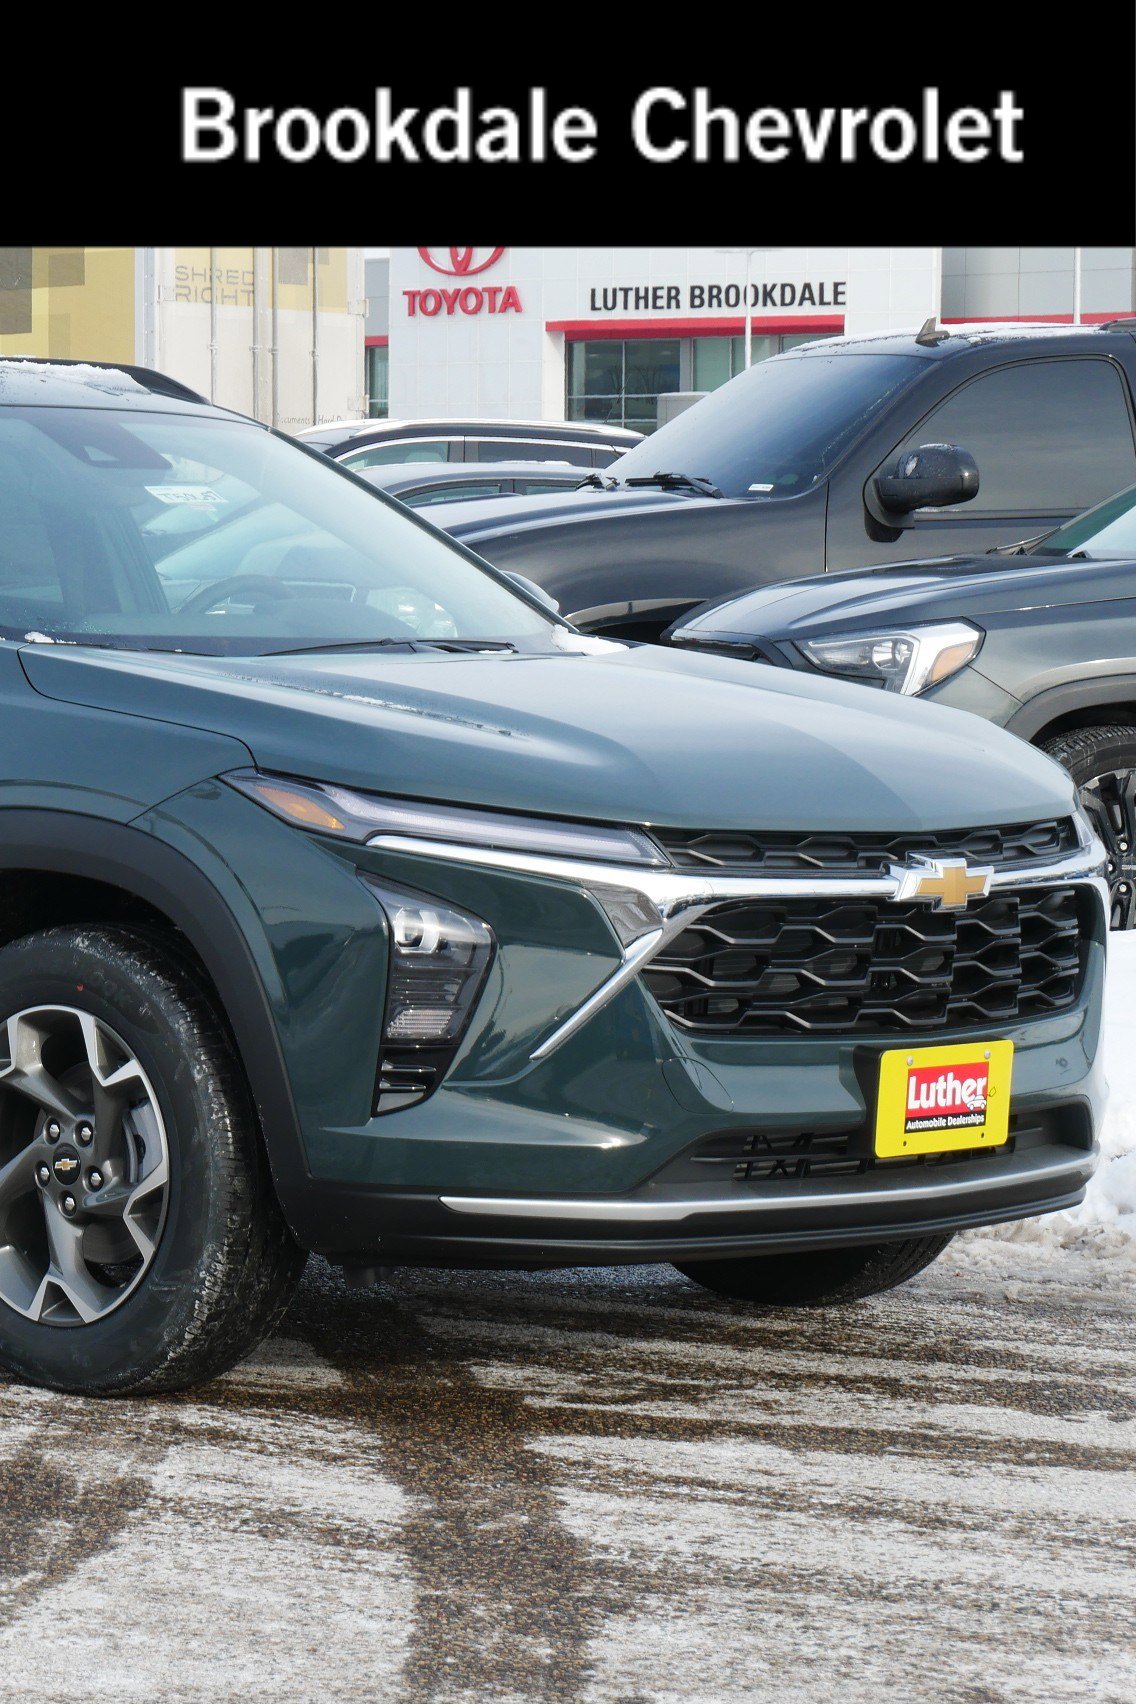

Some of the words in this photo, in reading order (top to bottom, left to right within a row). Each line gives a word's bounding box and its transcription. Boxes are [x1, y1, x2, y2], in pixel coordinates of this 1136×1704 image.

[175, 265, 254, 286] SHRED
[175, 284, 255, 307] RIGHT
[402, 286, 523, 317] TOYOTA
[590, 285, 681, 312] LUTHER
[689, 281, 847, 309] BROOKDALE
[907, 1071, 988, 1110] Luther
[906, 1117, 946, 1130] Automobile
[947, 1113, 985, 1125] Dealerships
